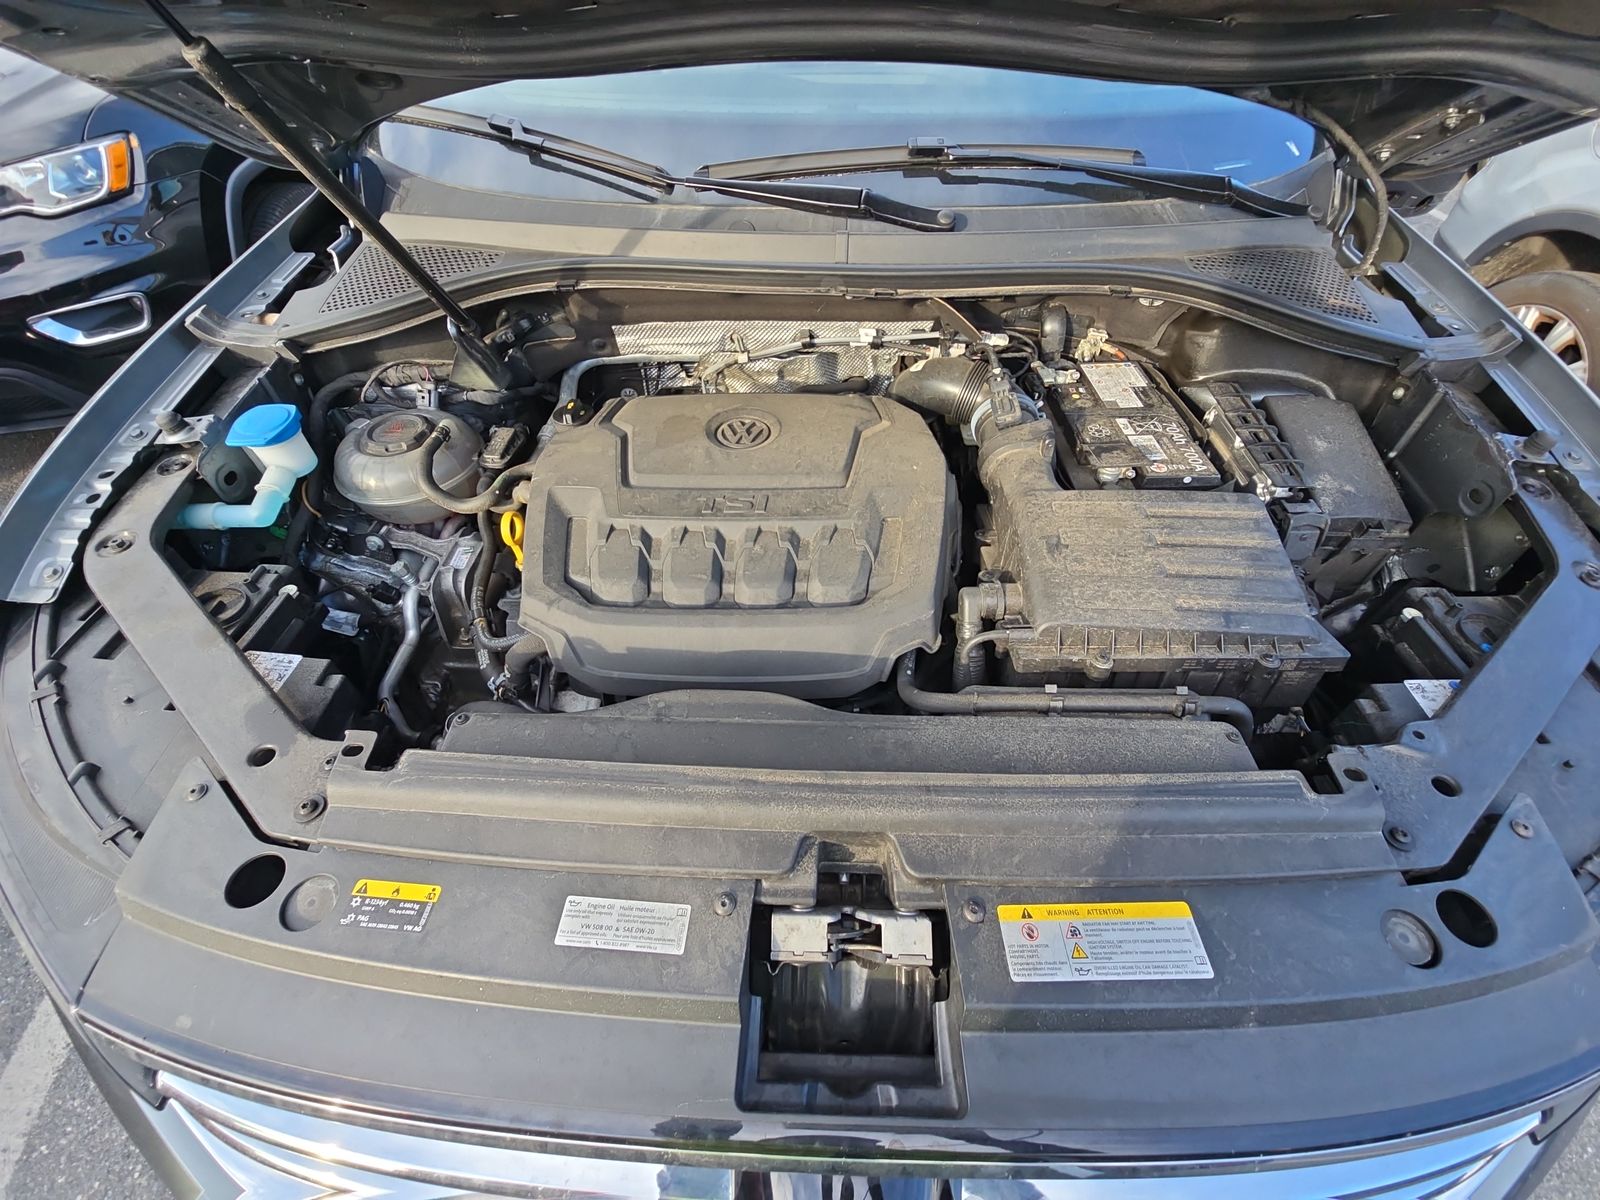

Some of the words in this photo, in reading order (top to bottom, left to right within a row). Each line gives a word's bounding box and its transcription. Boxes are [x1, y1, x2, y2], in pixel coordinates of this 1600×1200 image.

[1162, 422, 1188, 445] 70Ah
[1180, 446, 1208, 472] 700A
[697, 494, 770, 514] TSI
[587, 902, 607, 910] Engine
